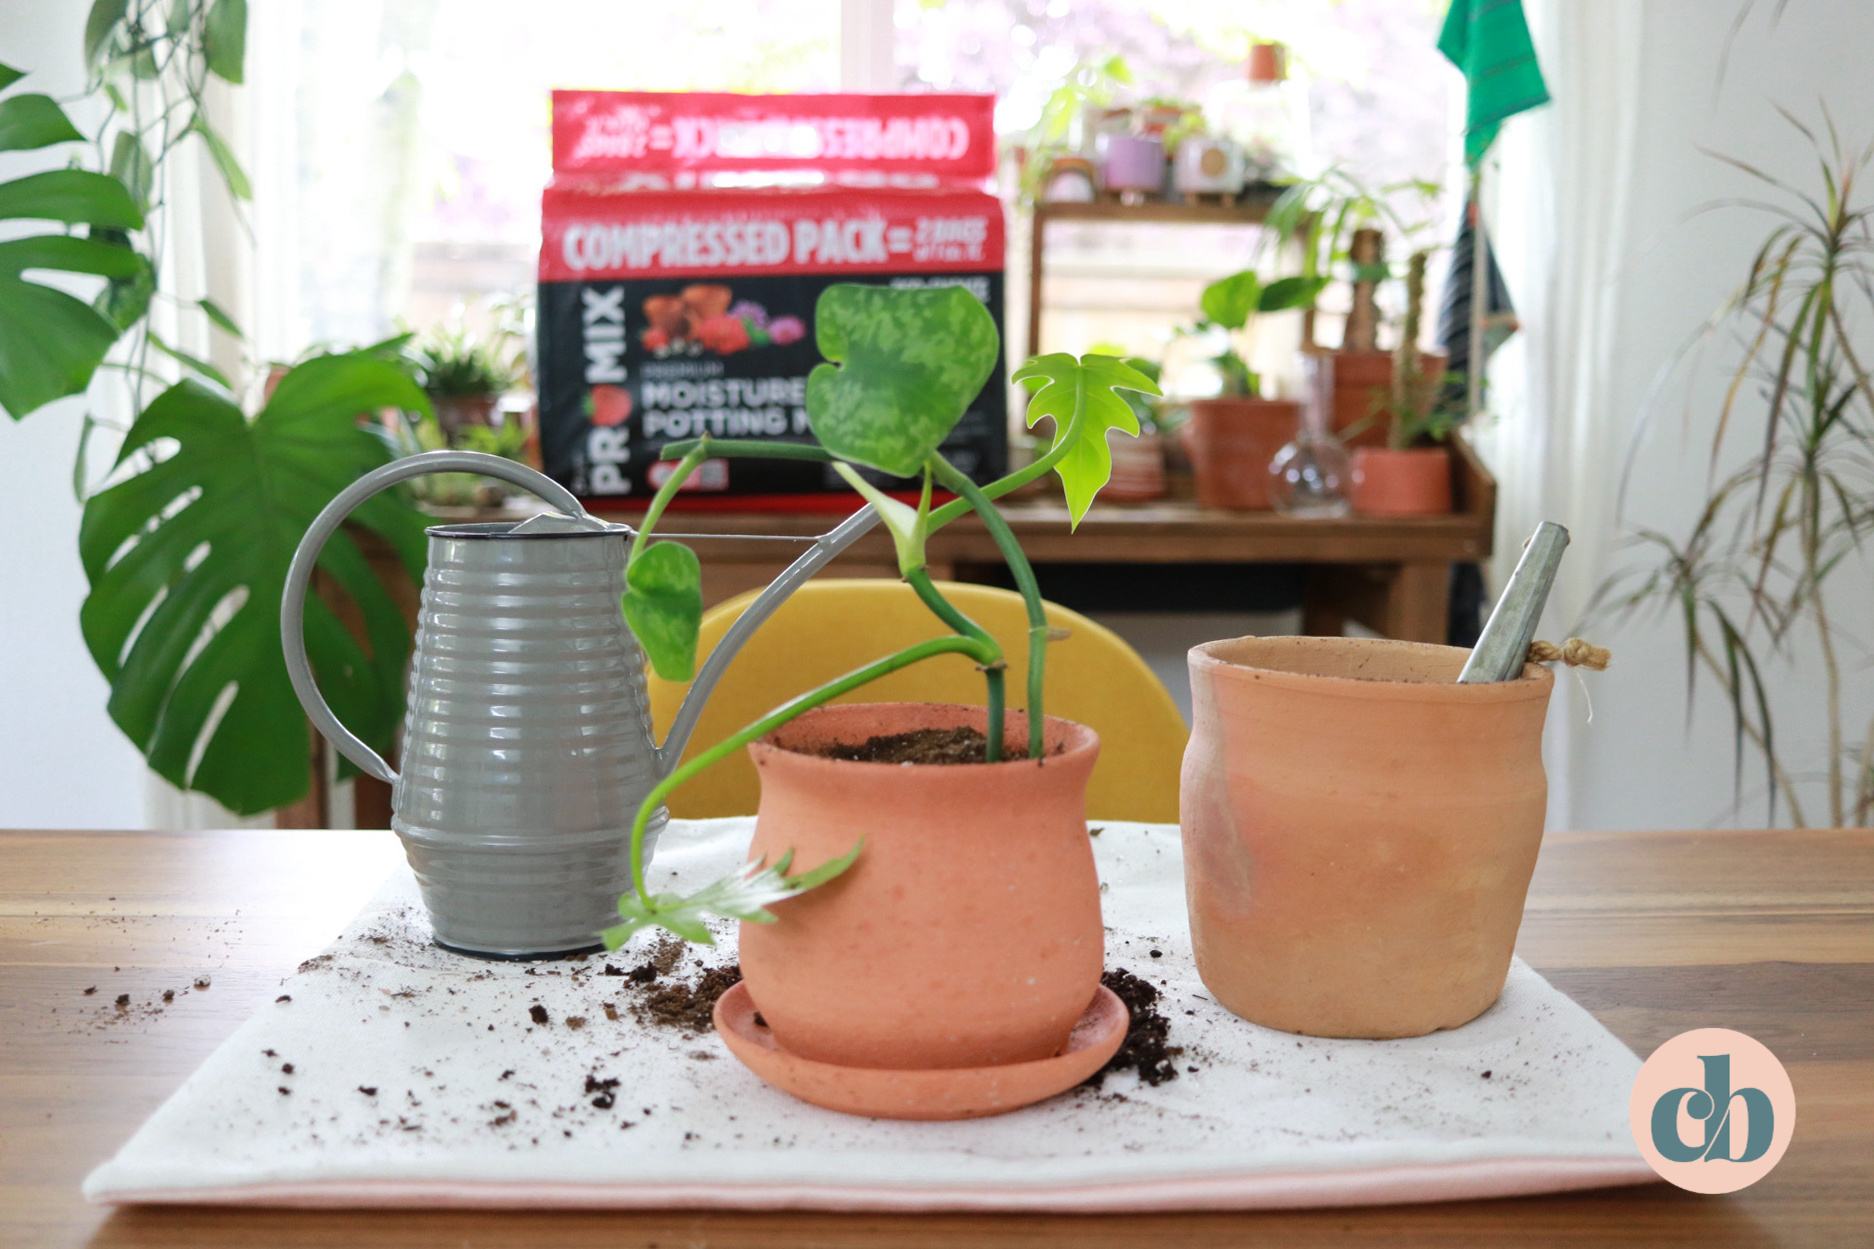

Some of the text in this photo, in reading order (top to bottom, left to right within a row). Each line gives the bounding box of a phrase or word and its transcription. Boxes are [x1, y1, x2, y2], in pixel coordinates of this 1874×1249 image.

[562, 220, 790, 270] COMPRESSED
[641, 376, 807, 410] MOISTURE
[642, 405, 788, 438] POTTING
